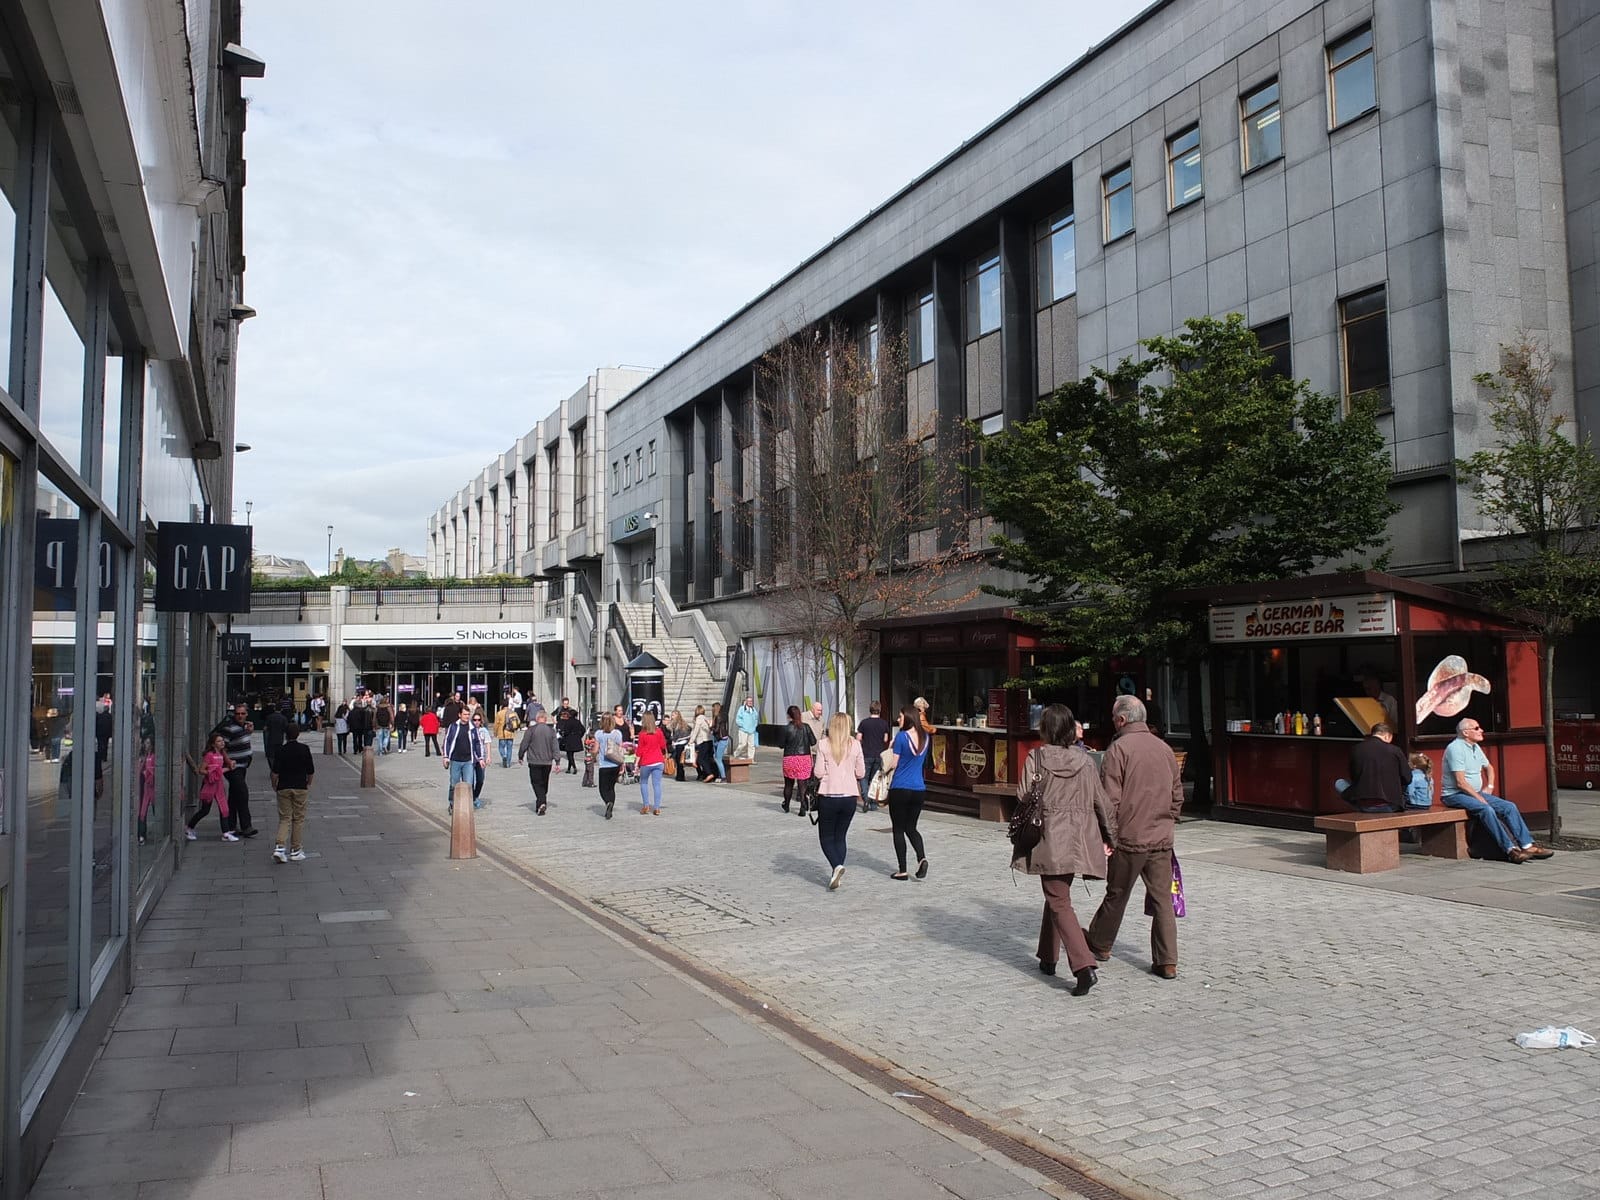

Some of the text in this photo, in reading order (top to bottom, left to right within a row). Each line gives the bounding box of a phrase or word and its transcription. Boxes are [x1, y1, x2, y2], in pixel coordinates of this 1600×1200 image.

[174, 544, 236, 591] GAP
[1263, 603, 1324, 621] GERMAN
[1245, 619, 1345, 637] SAUSAGE BAR
[456, 630, 469, 640] St
[472, 630, 528, 640] Nicholas
[227, 638, 245, 652] GAP
[1560, 744, 1573, 752] ON
[1557, 754, 1578, 762] SALE
[1585, 754, 1600, 762] SAL
[1584, 763, 1600, 772] HER
